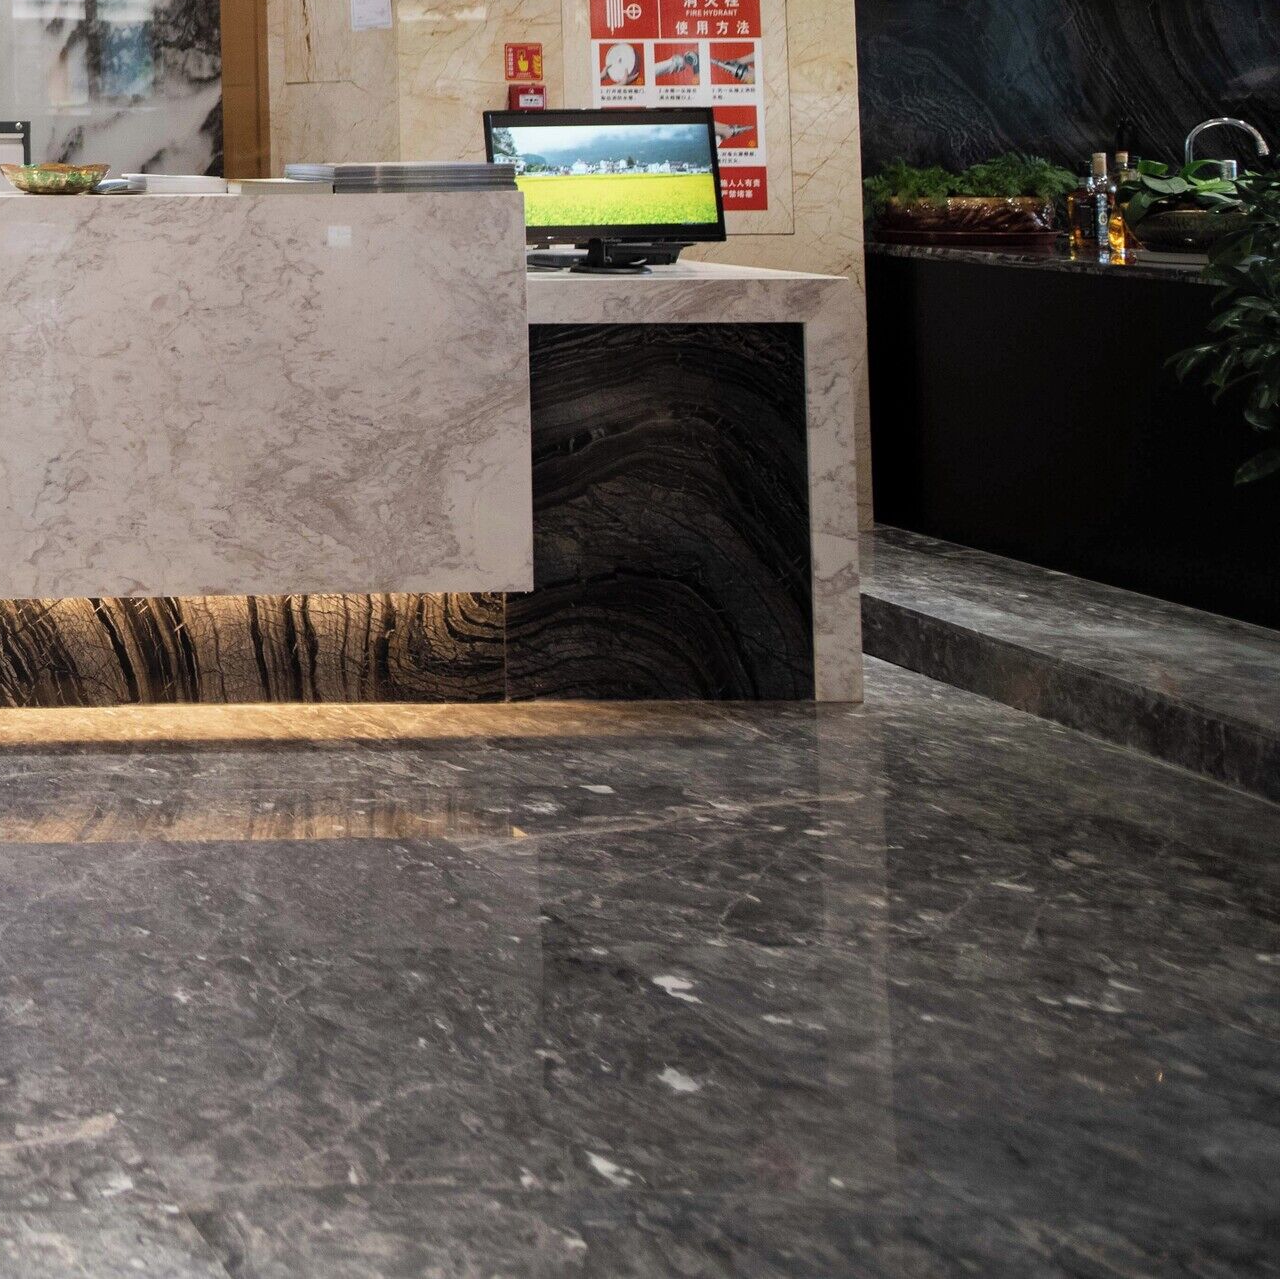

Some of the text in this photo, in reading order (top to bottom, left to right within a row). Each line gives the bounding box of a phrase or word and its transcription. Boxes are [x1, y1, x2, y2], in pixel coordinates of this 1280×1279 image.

[703, 9, 737, 17] HYDRANT
[675, 20, 750, 35] 使用方法
